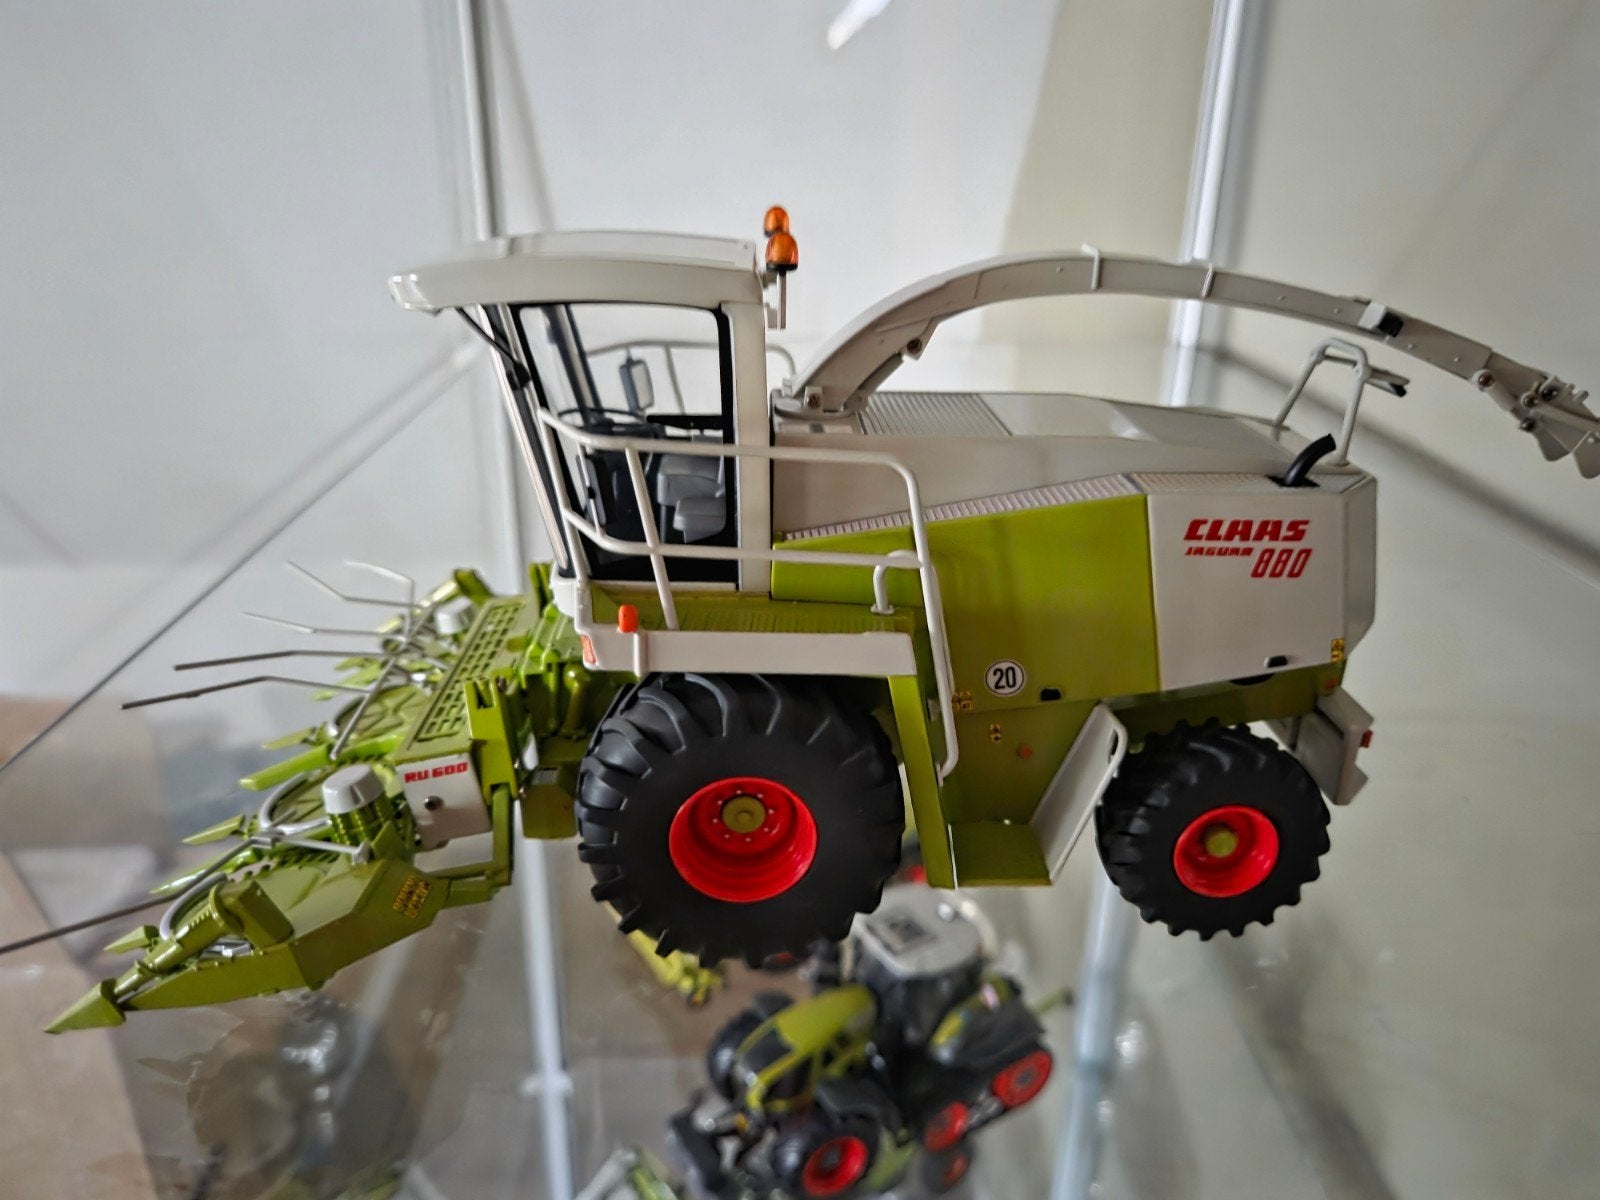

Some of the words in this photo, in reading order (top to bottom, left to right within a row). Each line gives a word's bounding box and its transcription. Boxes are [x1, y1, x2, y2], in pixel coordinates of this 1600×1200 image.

[1183, 518, 1311, 542] CLAAS
[1185, 546, 1253, 556] JAGUAR
[1250, 548, 1313, 578] 880
[992, 666, 1017, 690] 20
[404, 769, 429, 784] RU
[432, 761, 469, 778] 600
